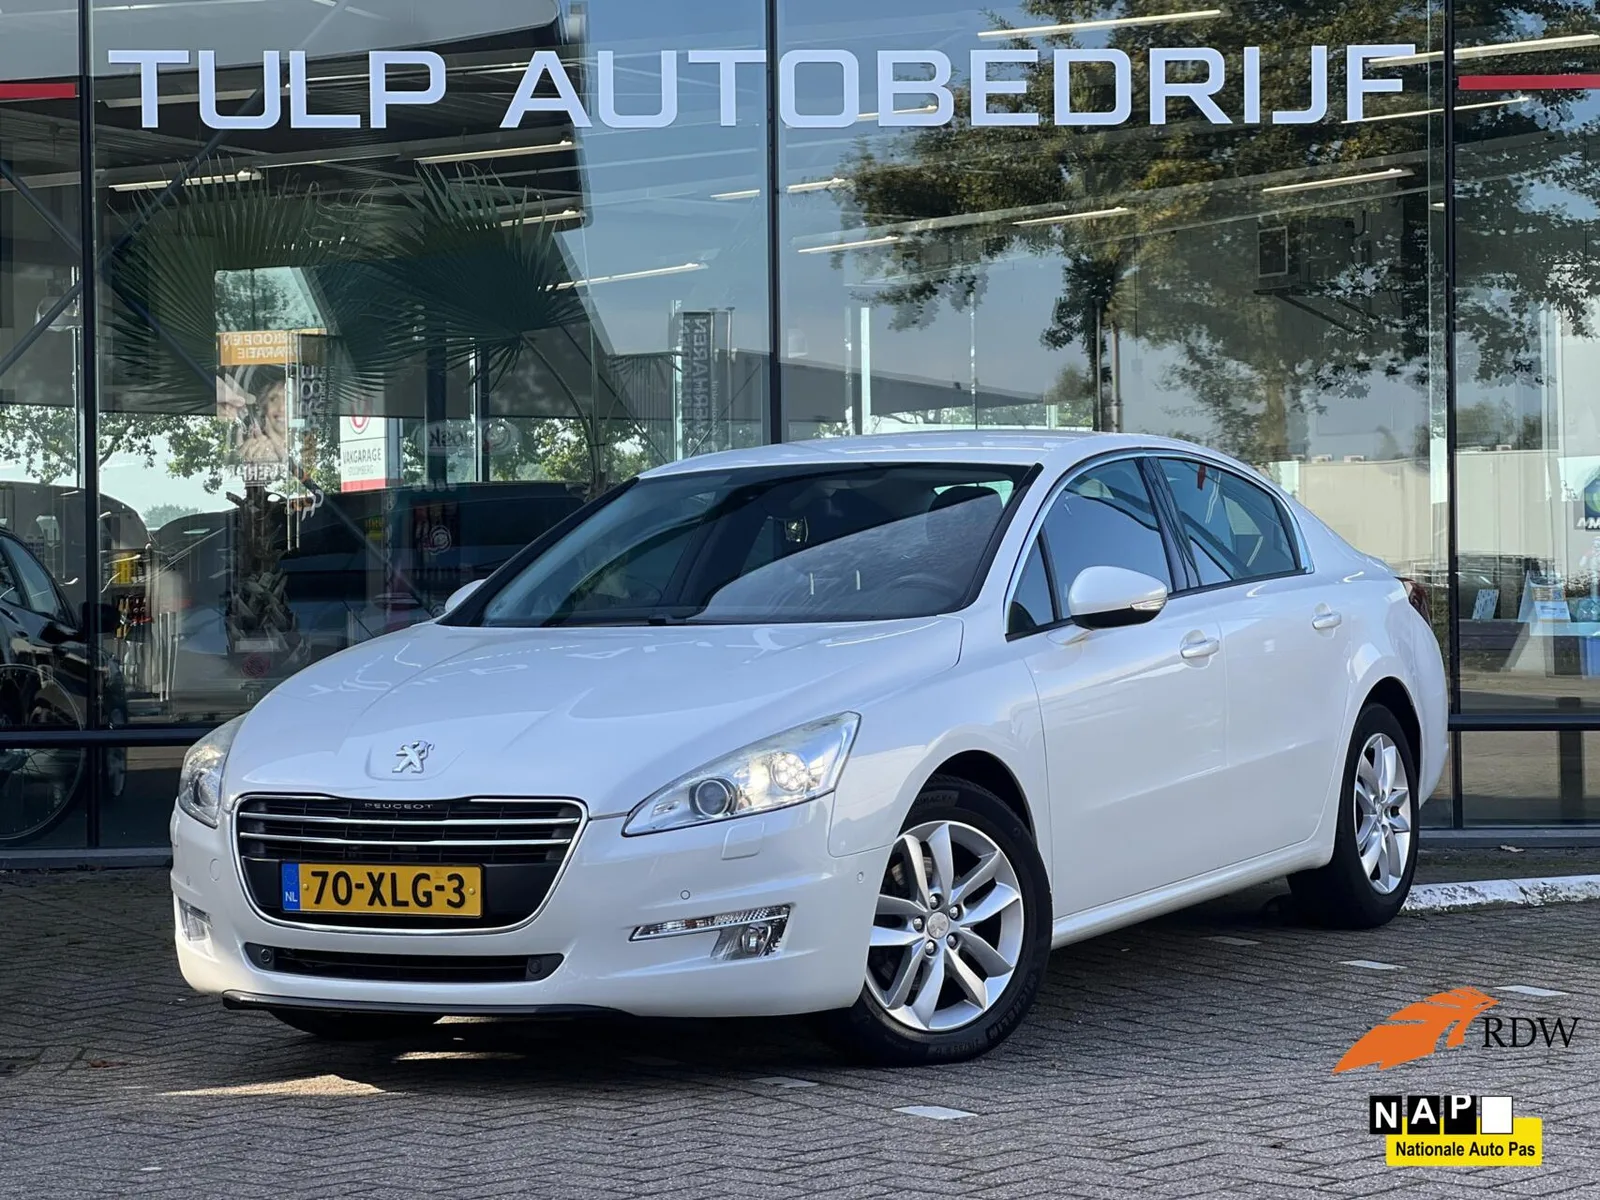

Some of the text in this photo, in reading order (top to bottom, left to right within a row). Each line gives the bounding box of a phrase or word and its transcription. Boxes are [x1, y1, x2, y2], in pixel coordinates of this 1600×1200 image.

[108, 44, 1416, 129] TULP AUTOBEDRIJF
[285, 871, 466, 909] NL 70-XLG-3
